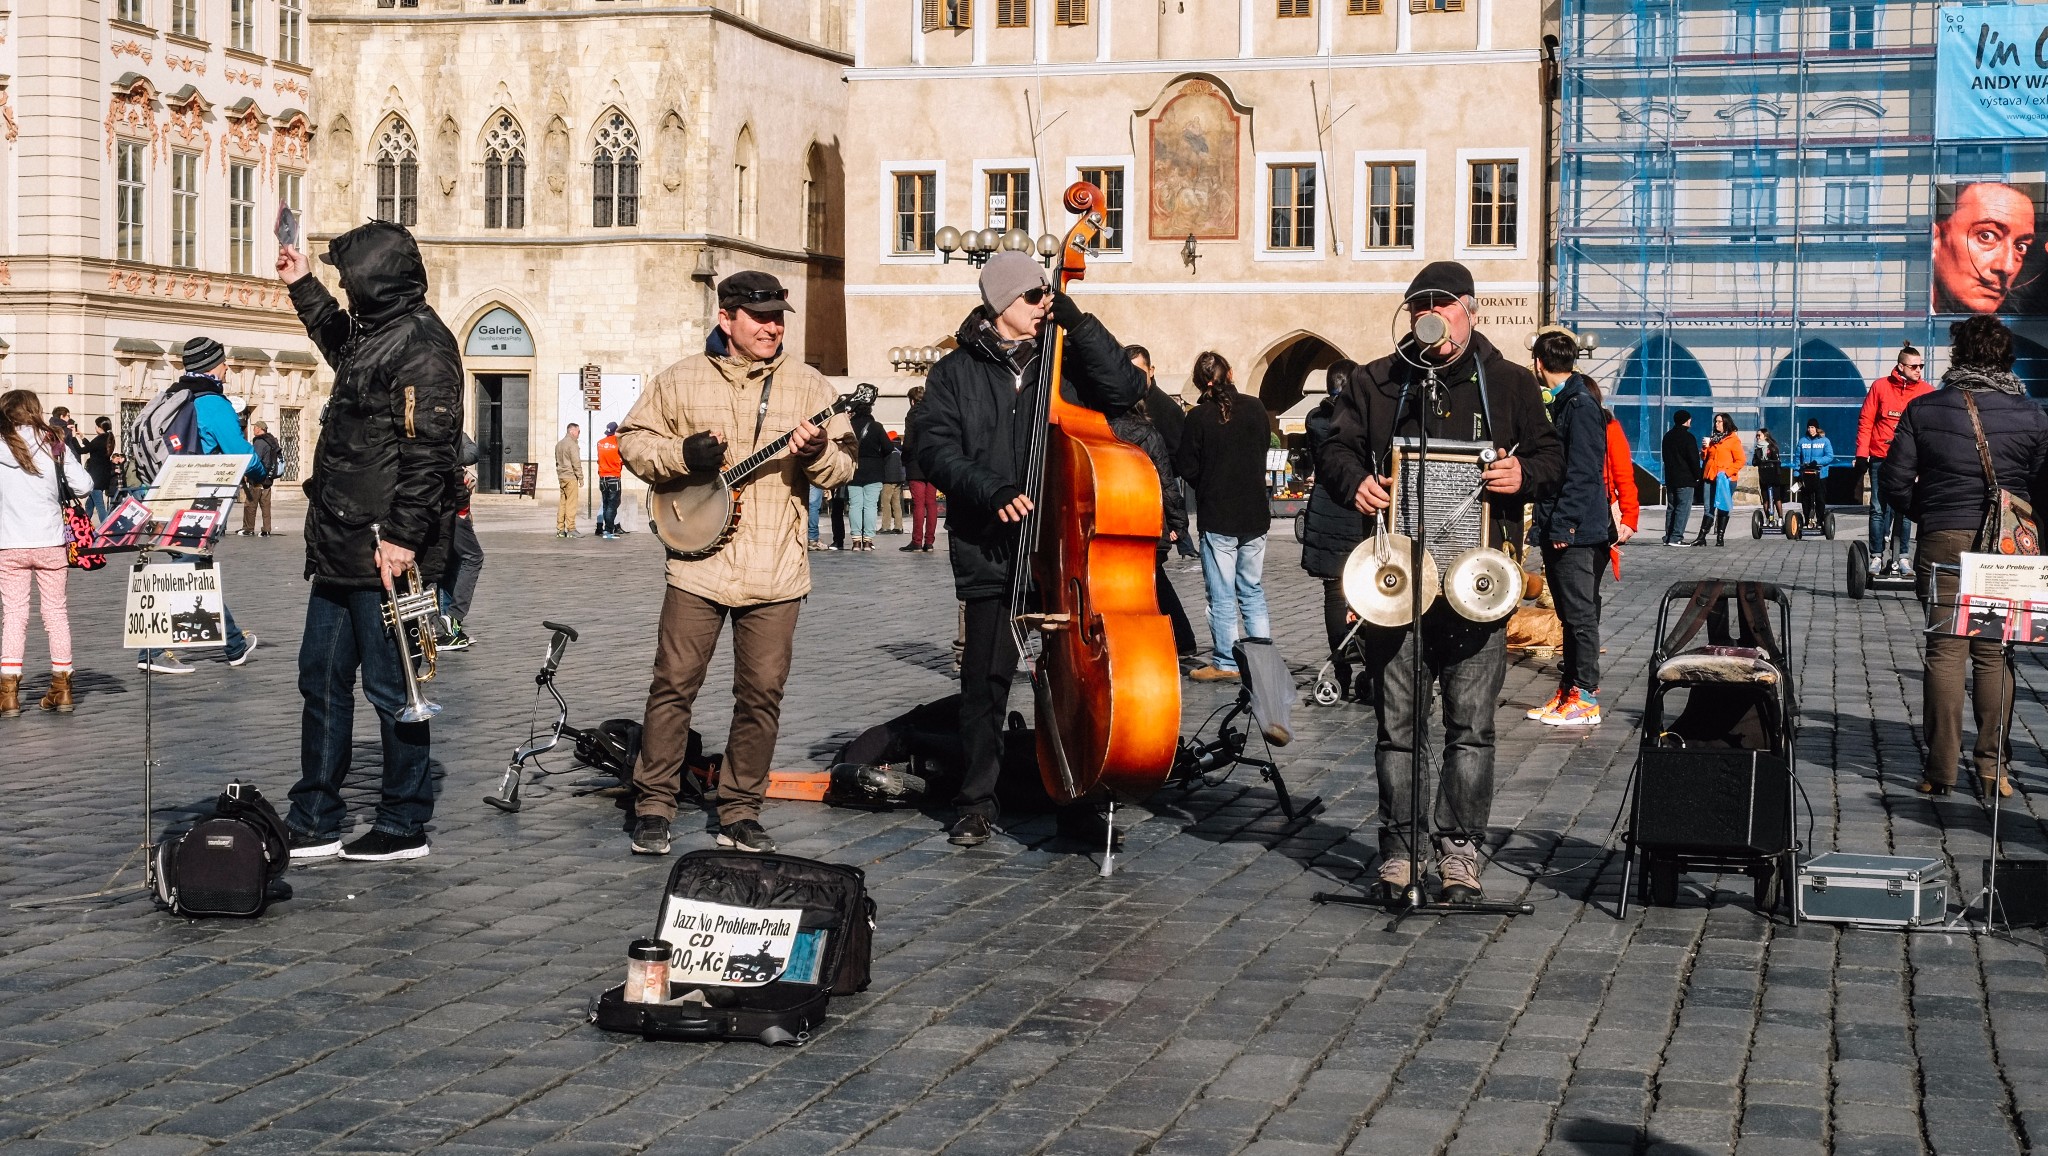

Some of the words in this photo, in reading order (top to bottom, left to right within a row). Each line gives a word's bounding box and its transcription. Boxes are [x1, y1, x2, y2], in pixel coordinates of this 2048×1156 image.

[1976, 23, 2020, 70] I'm
[1971, 75, 2021, 90] ANDY
[1980, 95, 2022, 108] výstava
[2032, 95, 2048, 106] ex
[1475, 298, 1528, 307] TORANTE
[1495, 316, 1534, 325] ITALIA
[478, 325, 522, 335] Galerie
[132, 575, 142, 593] Jazz
[143, 574, 151, 593] No
[153, 572, 215, 592] Problem-Praha
[140, 594, 155, 610] CD
[128, 612, 169, 640] 300,-Kč
[672, 909, 697, 930] Jazz
[699, 913, 712, 933] No
[714, 915, 791, 937] Problem-Praha
[688, 933, 714, 948] CD
[671, 947, 724, 975] 00,-Kč
